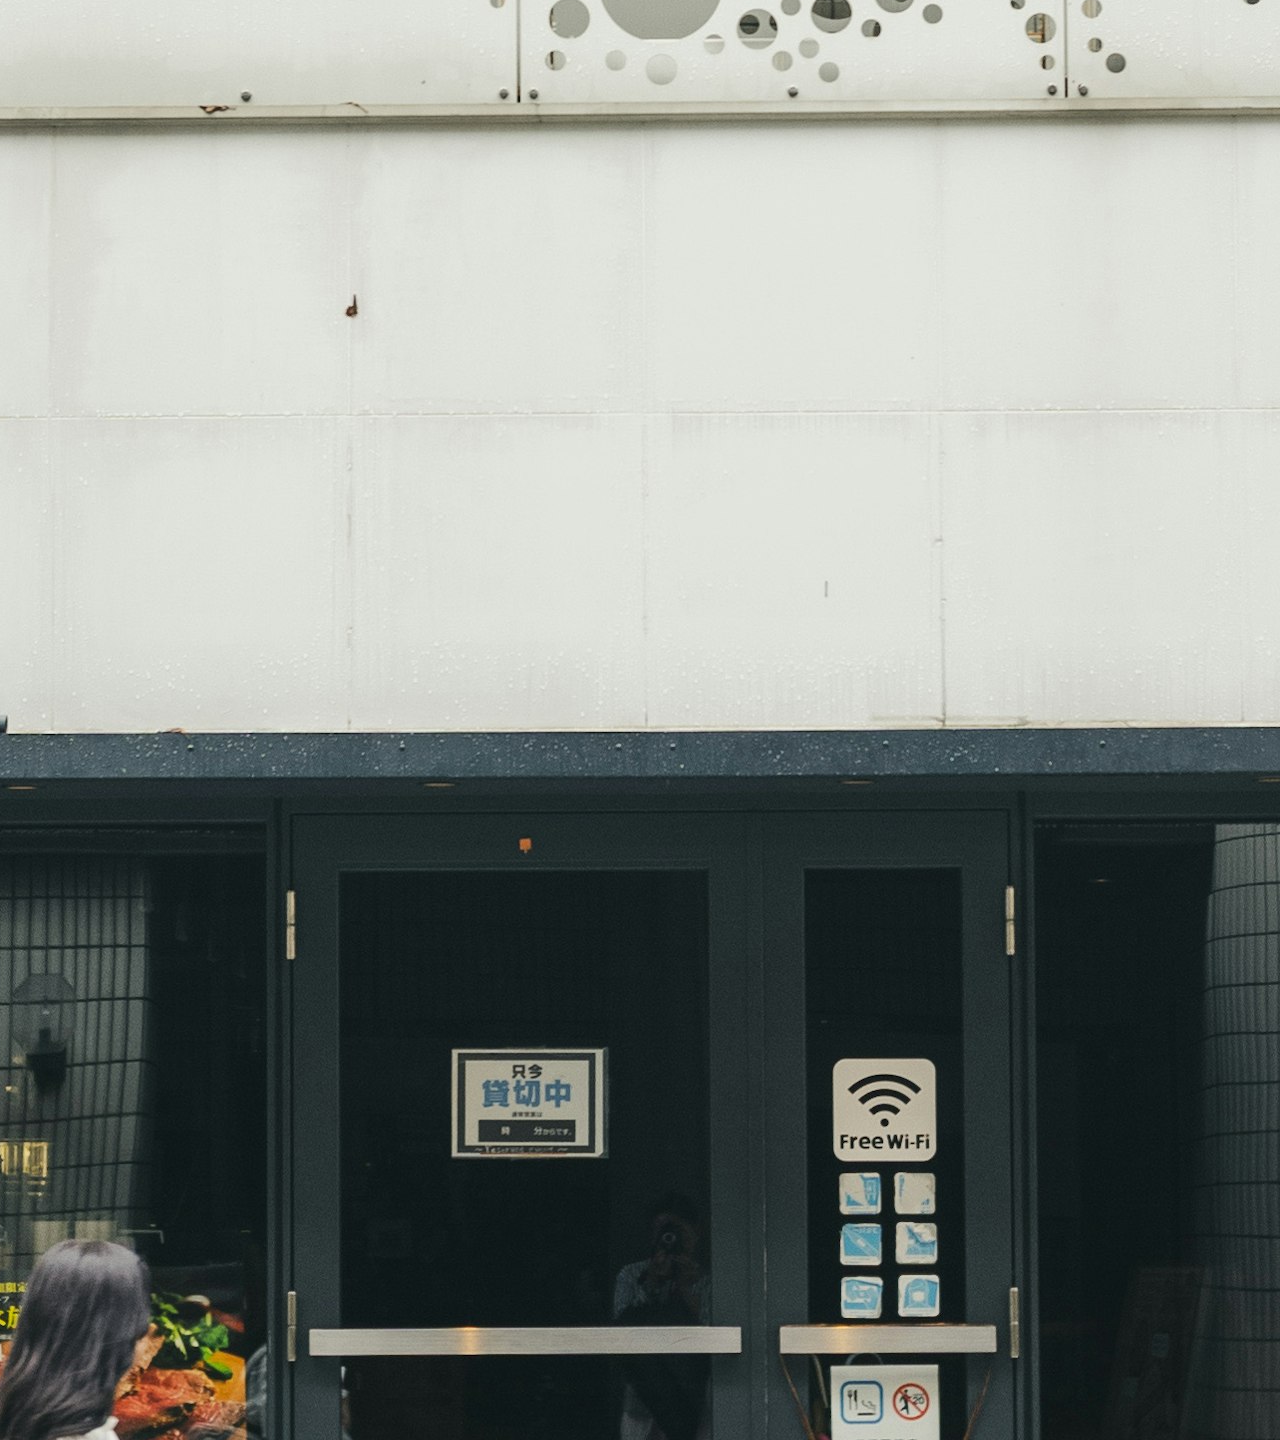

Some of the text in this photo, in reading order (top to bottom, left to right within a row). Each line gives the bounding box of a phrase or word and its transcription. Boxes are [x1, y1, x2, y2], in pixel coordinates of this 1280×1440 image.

[512, 1064, 543, 1079] 只今
[482, 1079, 571, 1108] 貸切中
[840, 1134, 931, 1150] Free Wi-Fi
